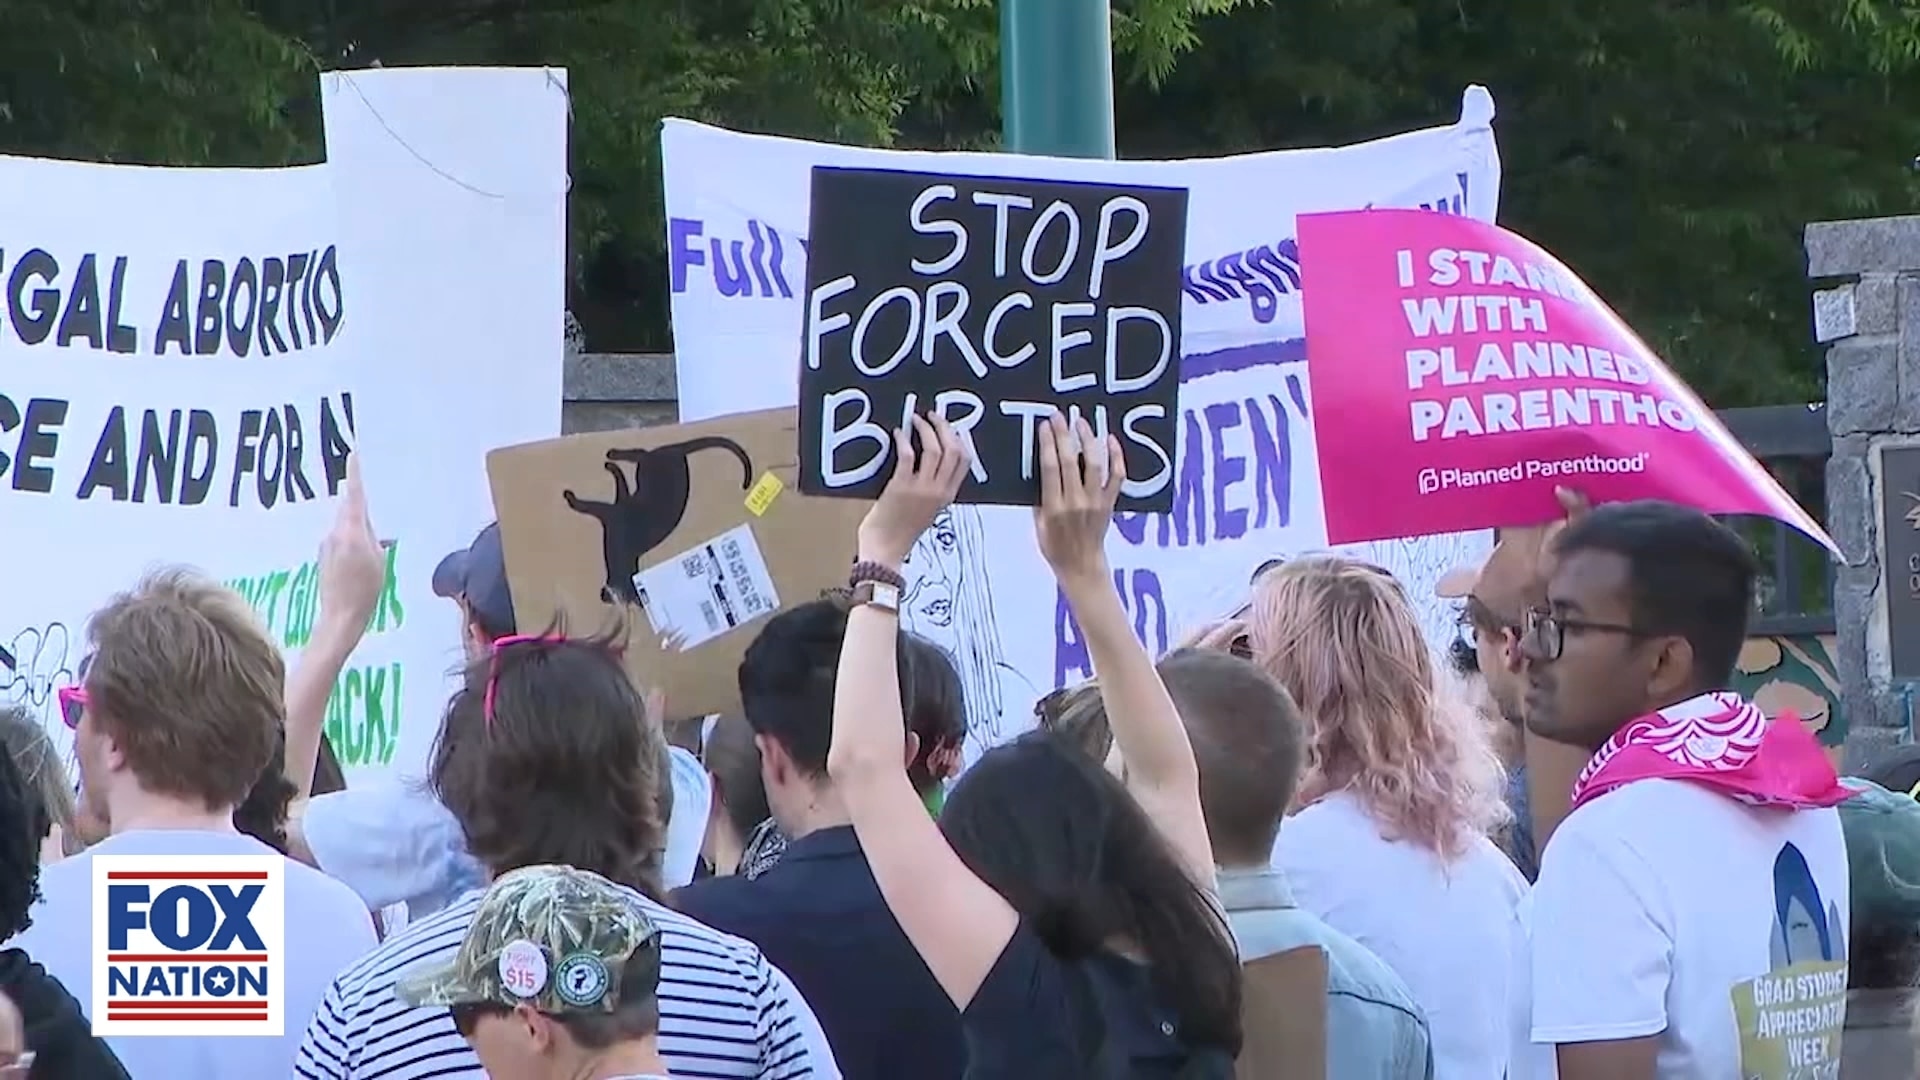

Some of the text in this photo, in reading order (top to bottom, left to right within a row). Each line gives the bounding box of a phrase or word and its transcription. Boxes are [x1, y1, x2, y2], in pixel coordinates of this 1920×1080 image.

[670, 217, 793, 299] Full
[909, 184, 1150, 299] STOP
[1397, 249, 1415, 288] I
[0, 247, 137, 354] GAL
[1401, 296, 1548, 337] WITH
[807, 275, 1173, 394] FORCED
[1405, 341, 1650, 390] PLANNED
[1410, 387, 1697, 442] PARENTHO
[76, 405, 218, 505] AND
[229, 403, 315, 510] FOR
[1441, 452, 1645, 489] Planned Parenthood
[324, 662, 401, 765] ACK!
[506, 966, 535, 989] $15
[1753, 976, 1795, 1007] GRAD
[1787, 1035, 1830, 1069] WEEK
